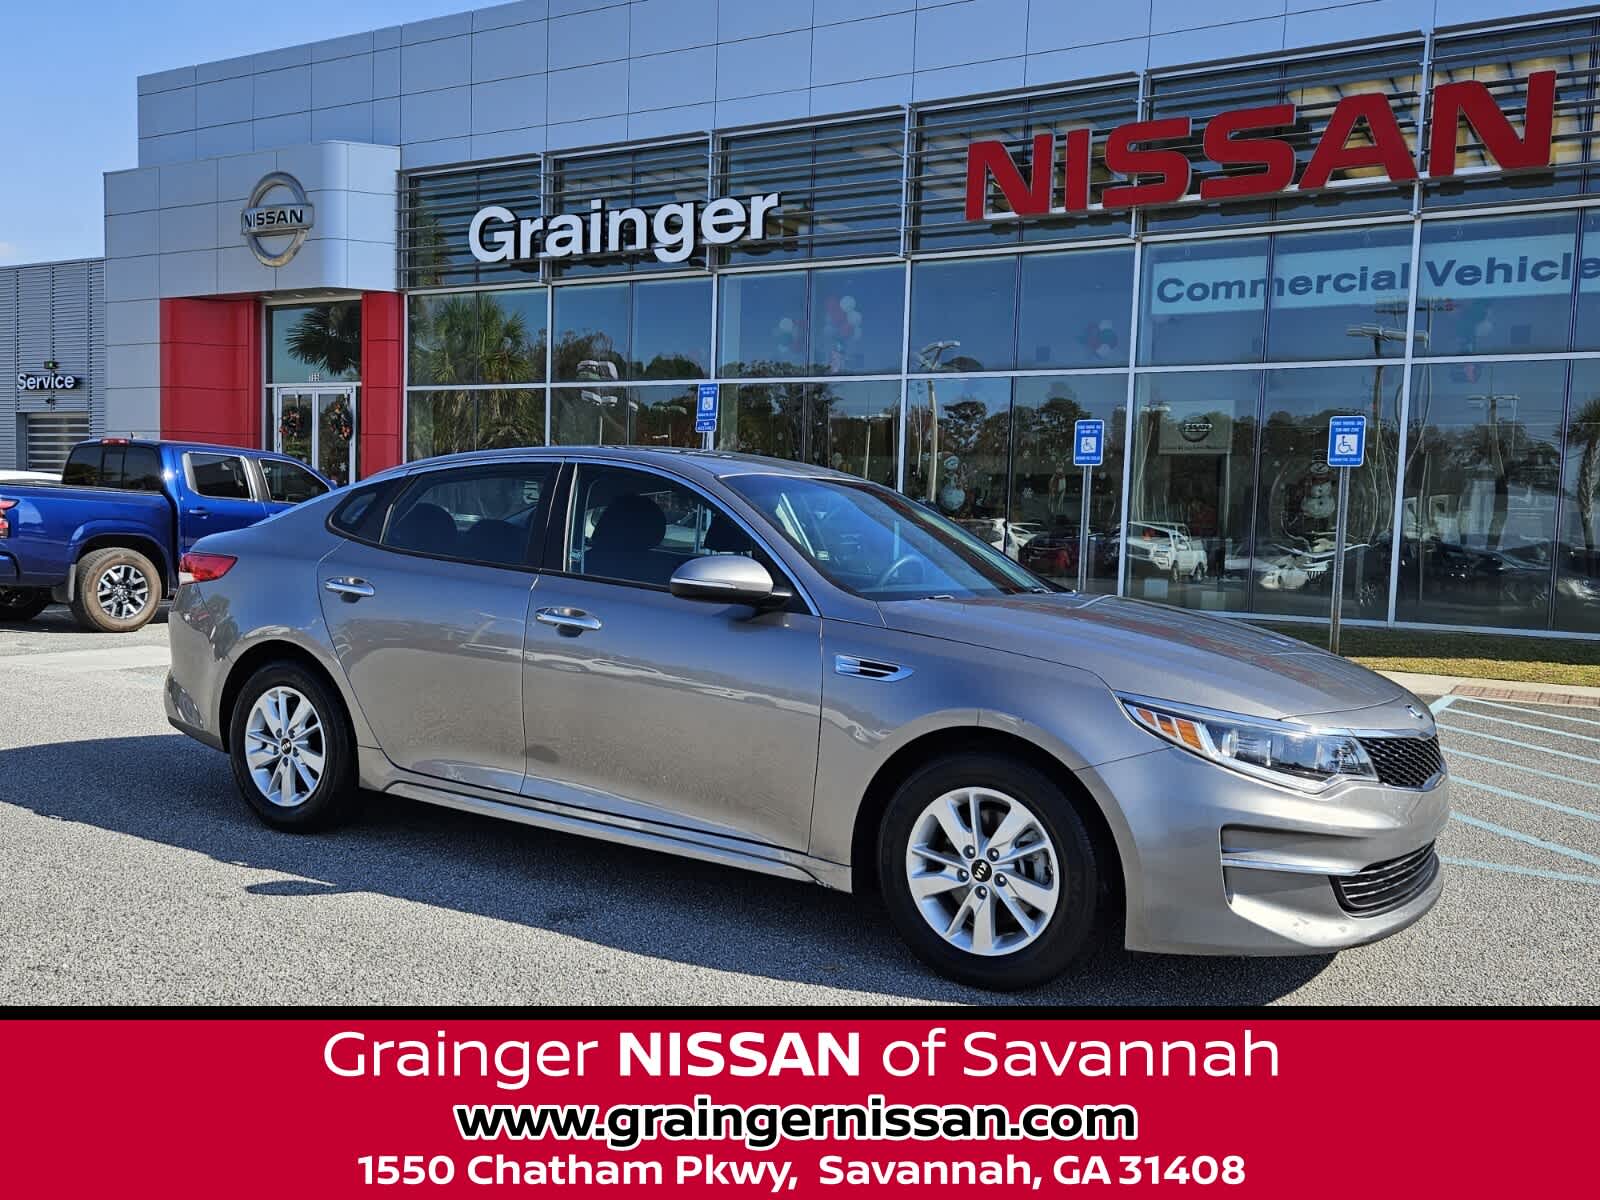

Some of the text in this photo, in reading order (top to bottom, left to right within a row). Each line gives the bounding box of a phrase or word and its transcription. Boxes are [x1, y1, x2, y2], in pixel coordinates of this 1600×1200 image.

[966, 71, 1556, 220] NISSAN
[244, 209, 304, 228] NISSAN
[470, 193, 779, 263] Grainger
[1157, 251, 1600, 304] Commercial Vehicle
[16, 373, 75, 390] Service
